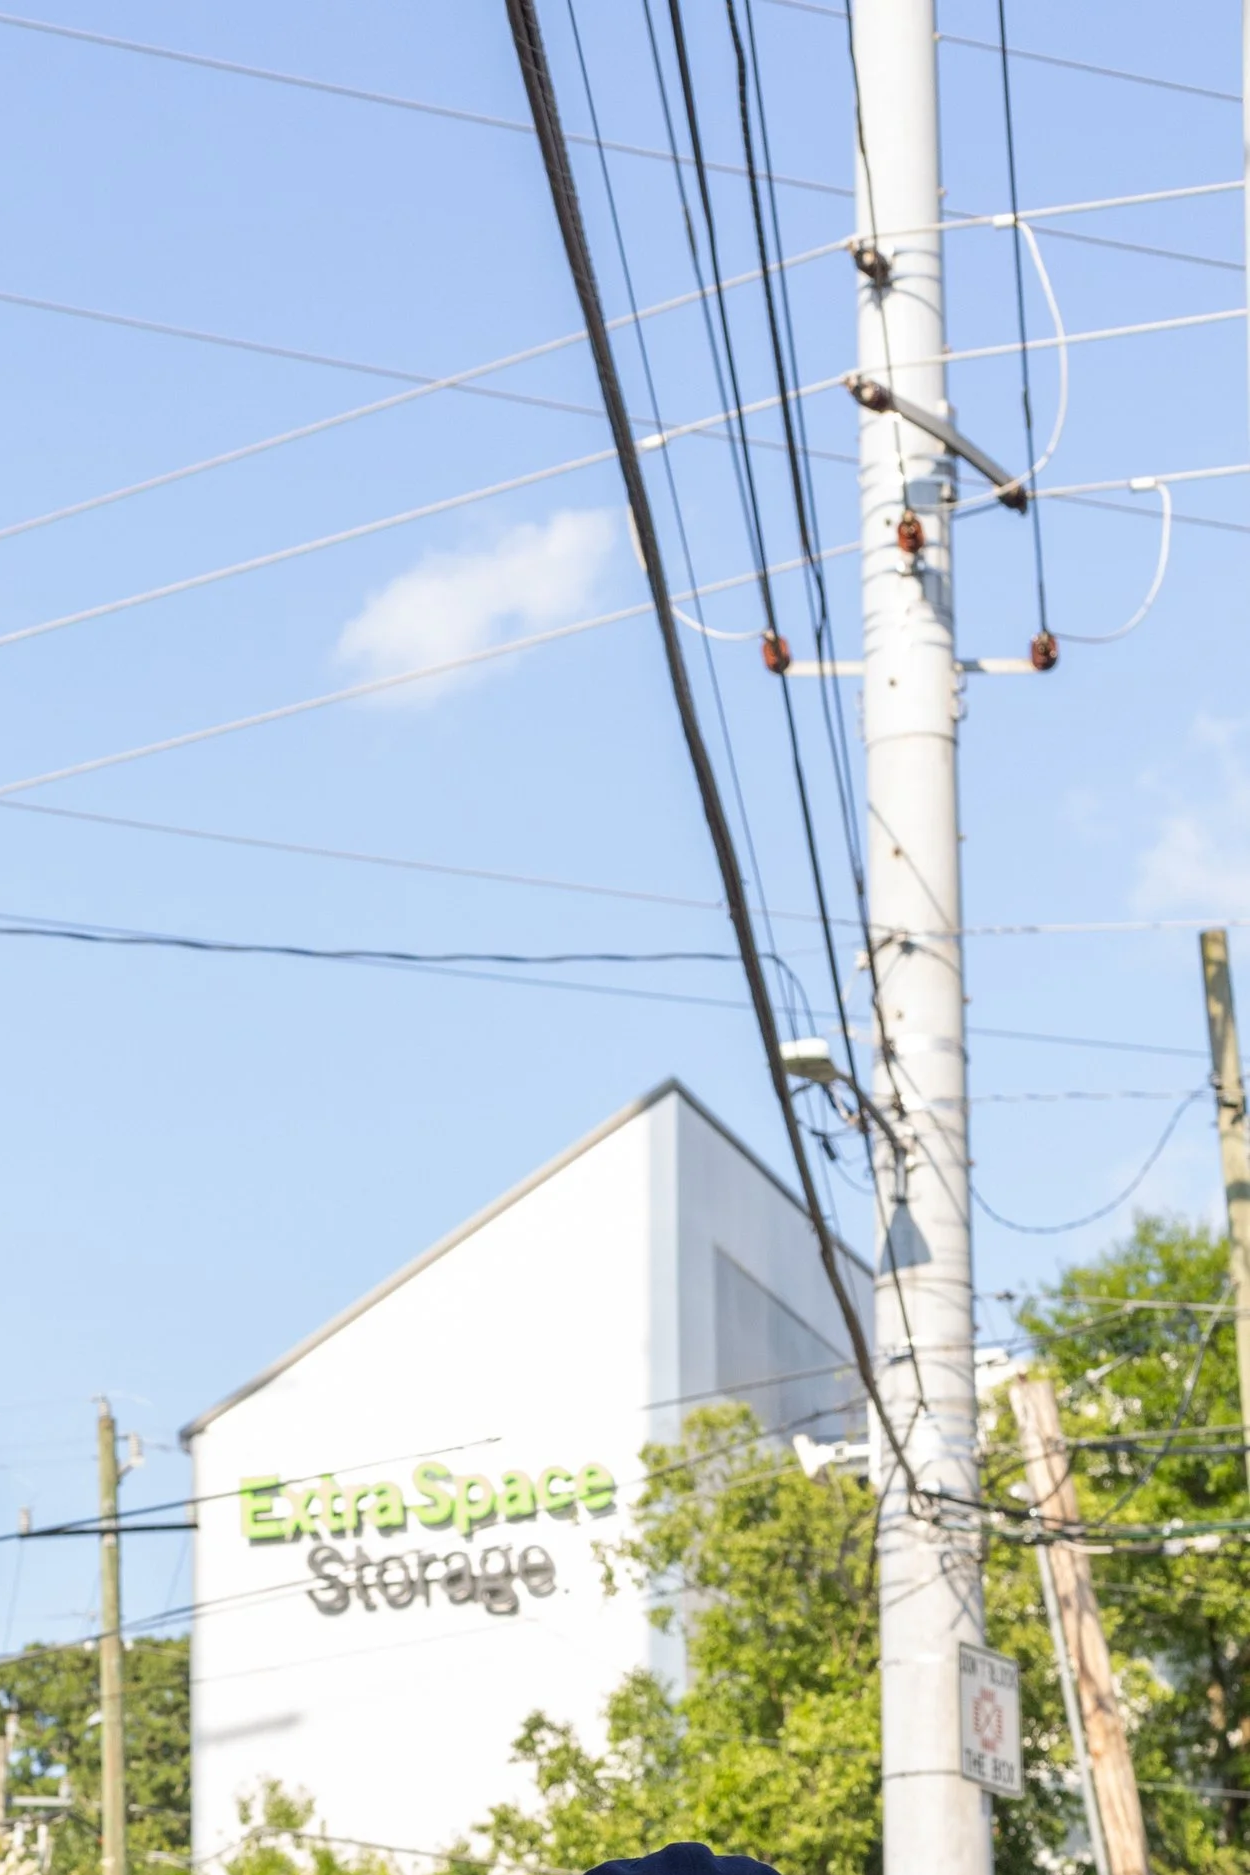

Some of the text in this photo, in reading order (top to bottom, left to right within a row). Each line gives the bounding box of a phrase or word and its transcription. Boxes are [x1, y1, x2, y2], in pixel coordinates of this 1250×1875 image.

[240, 1461, 617, 1545] Extra Space
[307, 1545, 557, 1616] Storage
